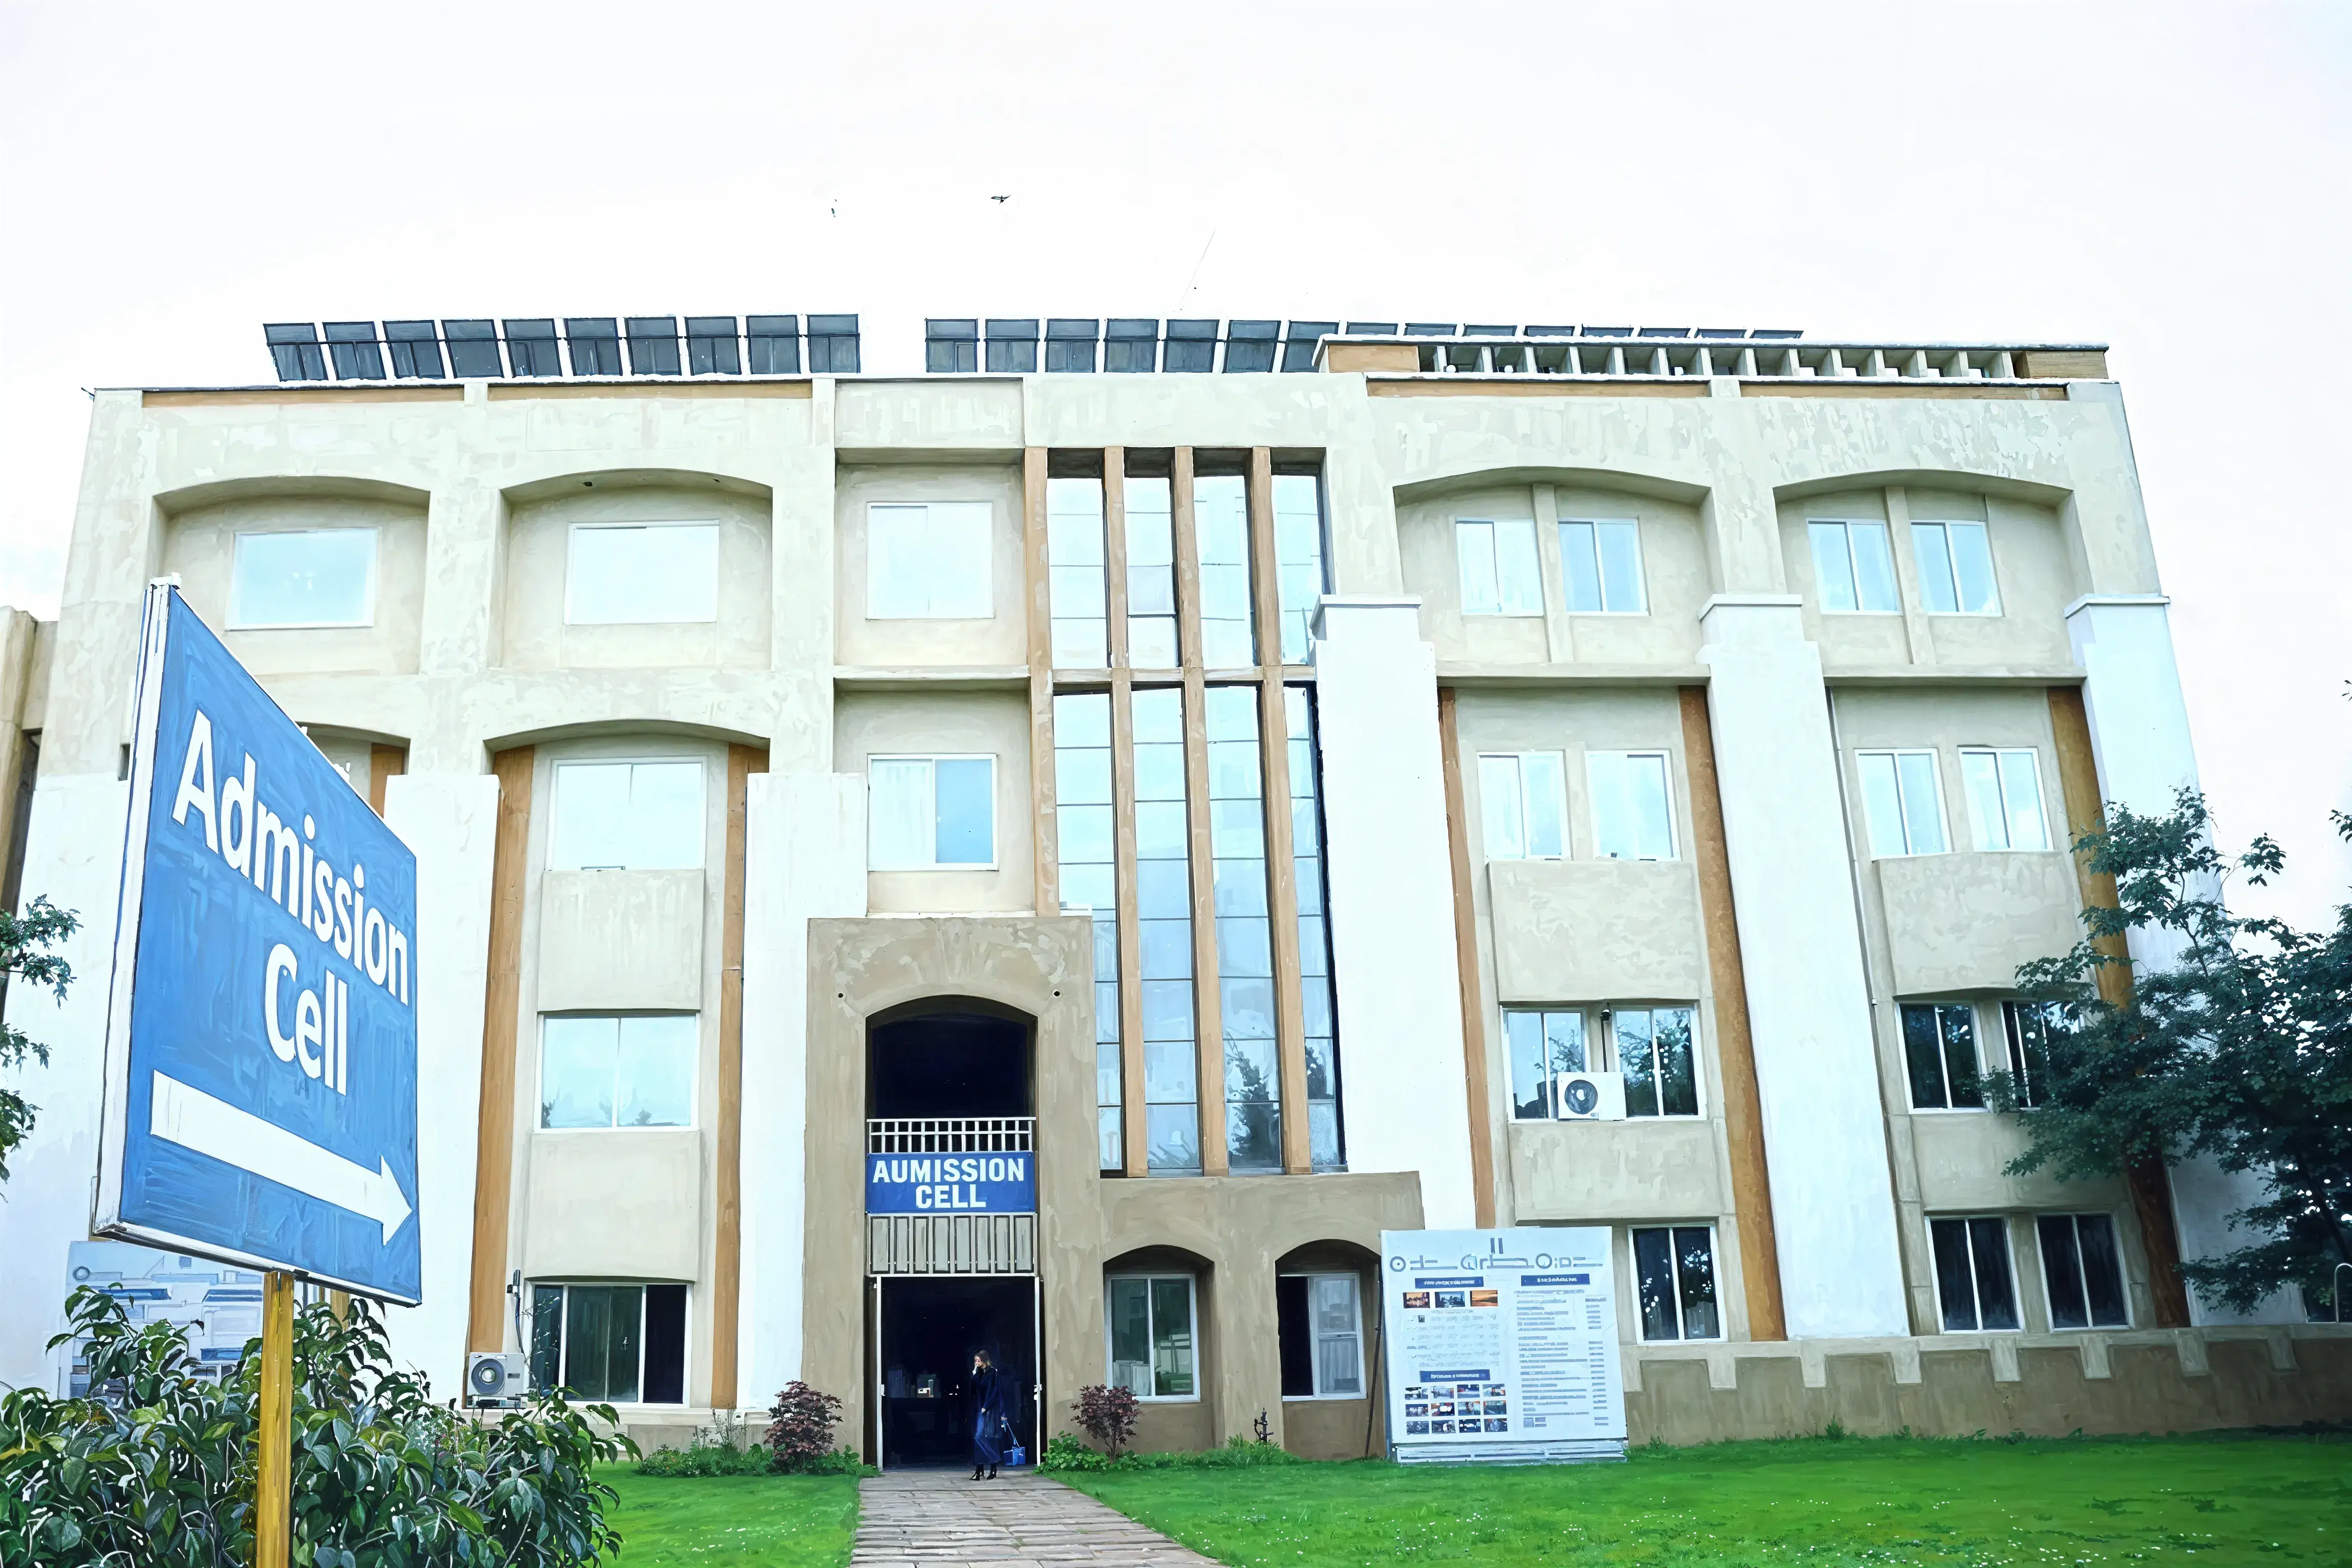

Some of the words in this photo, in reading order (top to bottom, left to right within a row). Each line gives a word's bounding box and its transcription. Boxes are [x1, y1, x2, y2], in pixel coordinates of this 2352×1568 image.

[173, 709, 408, 1006] Admission
[265, 943, 348, 1096] Cell
[916, 1184, 987, 1209] CELL
